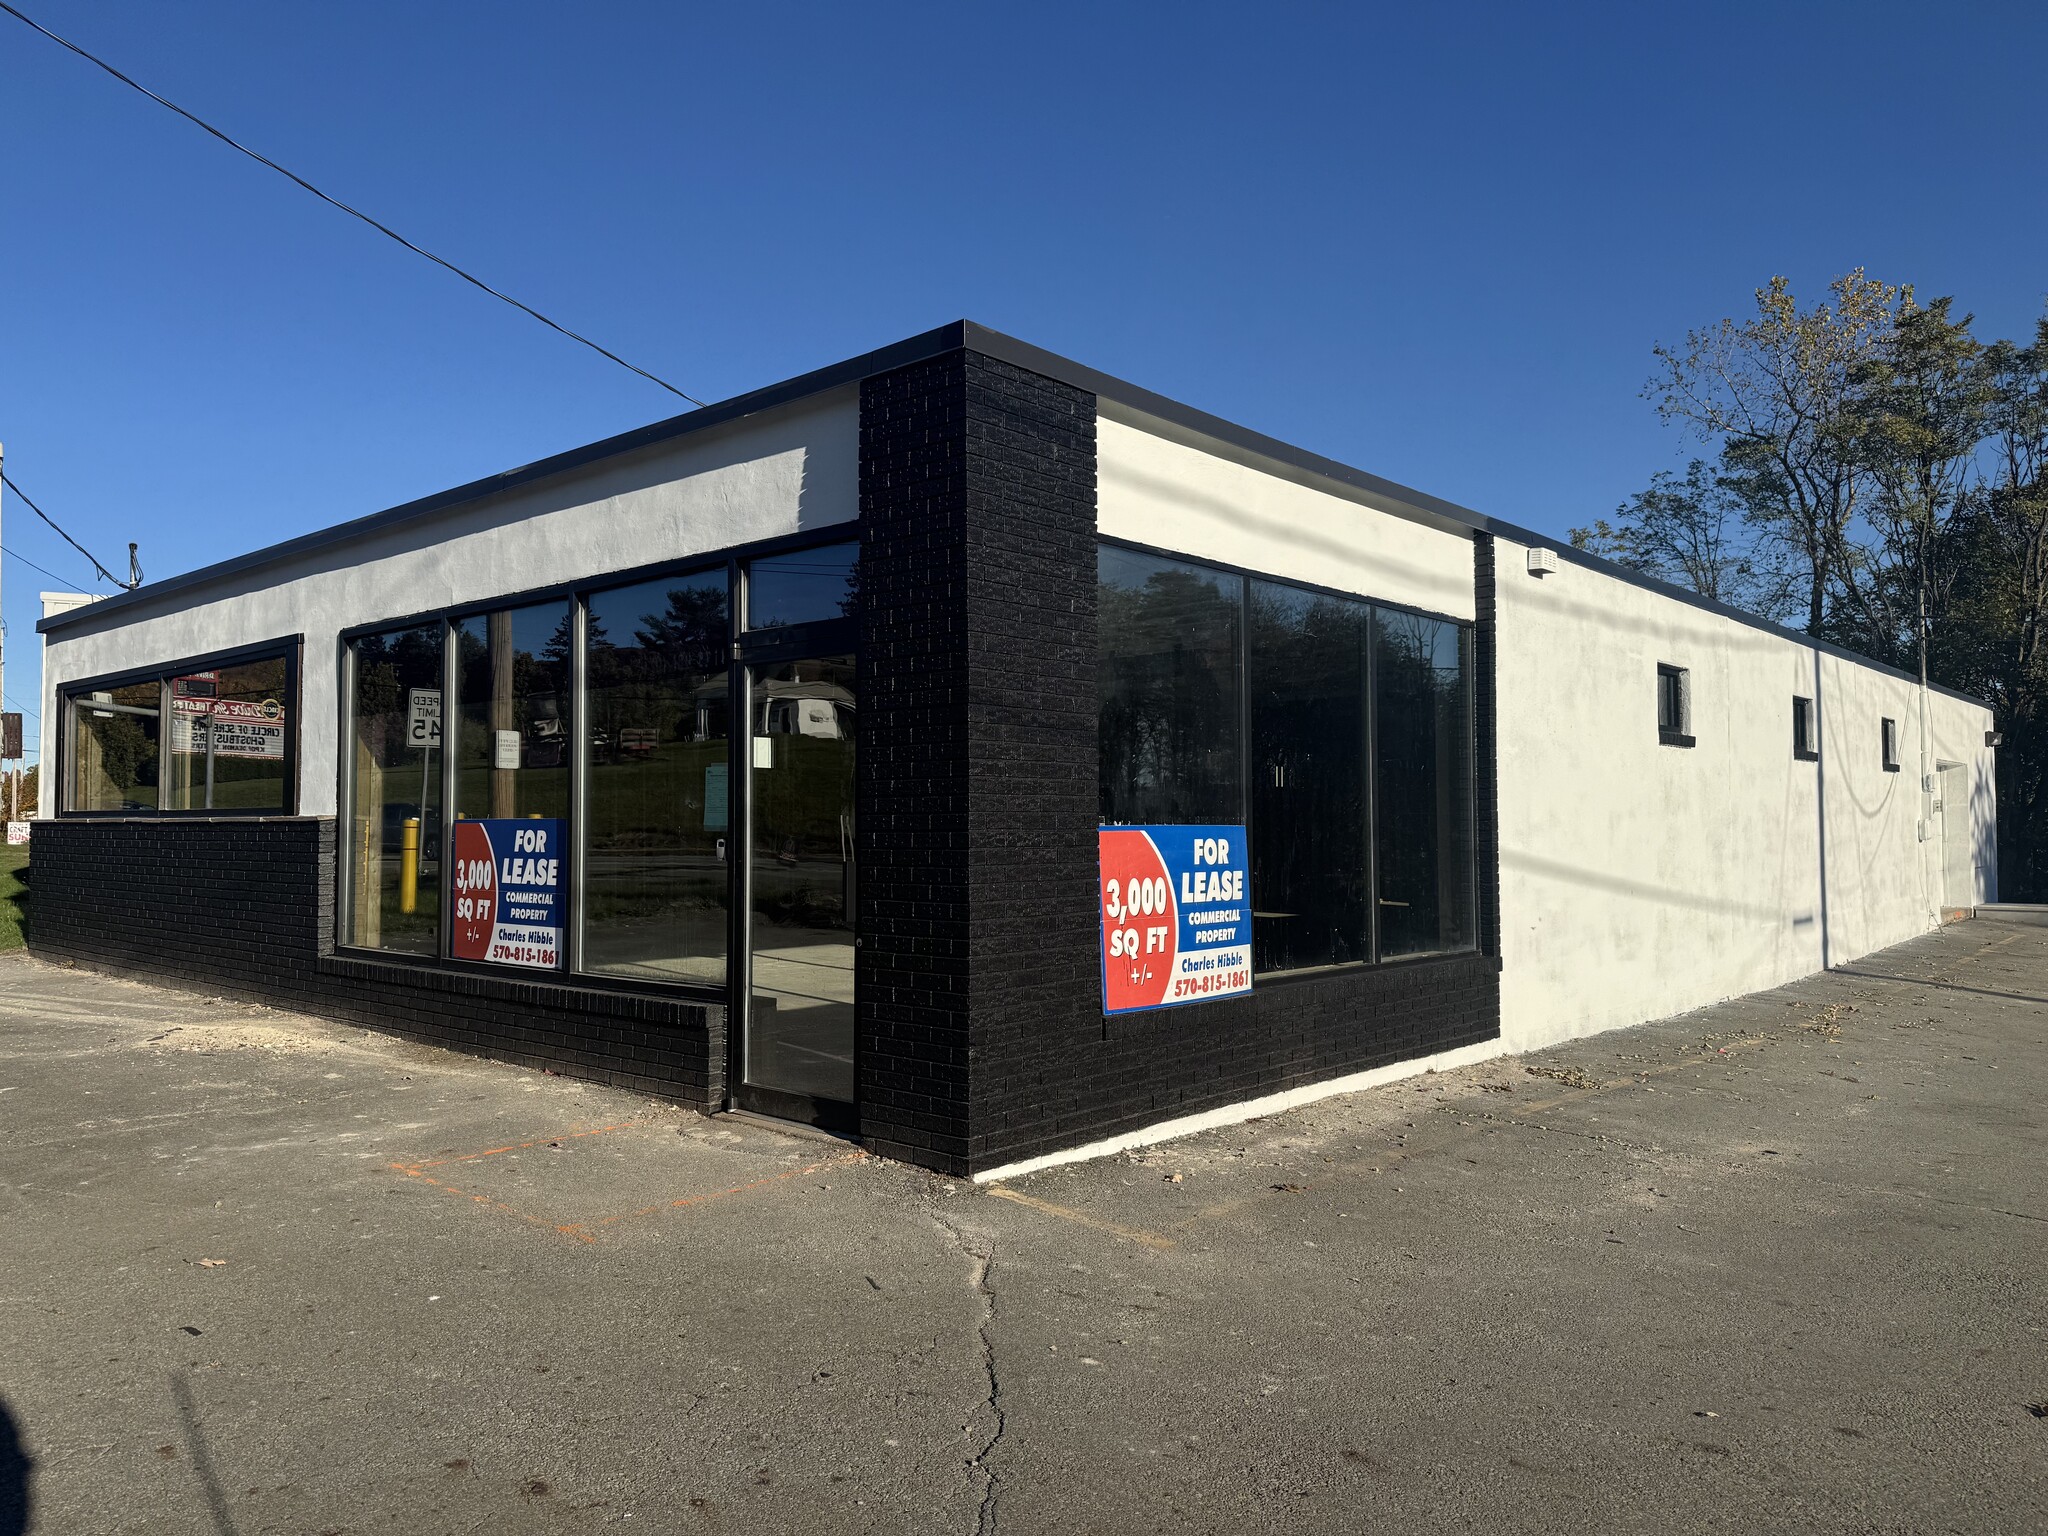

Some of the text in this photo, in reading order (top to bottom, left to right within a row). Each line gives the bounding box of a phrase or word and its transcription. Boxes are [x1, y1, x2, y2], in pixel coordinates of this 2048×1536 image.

[514, 829, 547, 853] FOR
[1193, 838, 1229, 865] FOR
[457, 859, 492, 895] 3,000
[501, 858, 559, 886] LEASE
[505, 891, 554, 905] COMMERCIAL
[1181, 870, 1243, 904] LEASE
[456, 898, 491, 922] SQ FT
[1106, 876, 1167, 925] 3,000
[510, 908, 548, 921] PROPERTY
[1188, 909, 1241, 925] COMMERCIAL
[498, 928, 554, 945] Charles Hibble
[1109, 926, 1168, 960] SQ FT
[1195, 927, 1236, 944] PROPERTY
[492, 944, 560, 965] 570-815-1861
[1181, 951, 1243, 973] Charles Hibble
[1174, 969, 1249, 997] 570-815-1861
